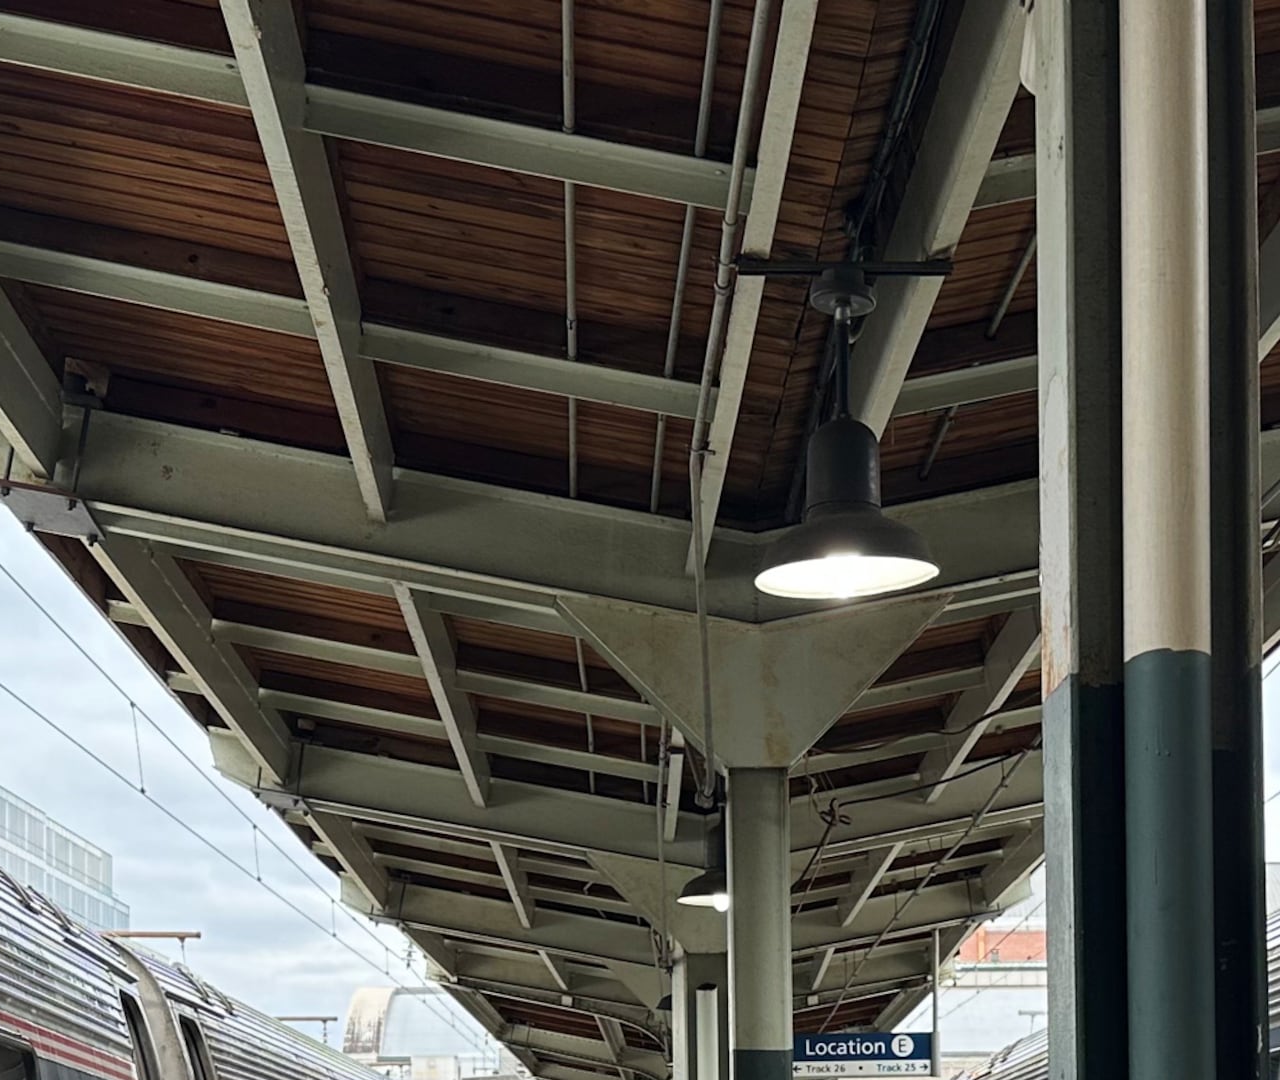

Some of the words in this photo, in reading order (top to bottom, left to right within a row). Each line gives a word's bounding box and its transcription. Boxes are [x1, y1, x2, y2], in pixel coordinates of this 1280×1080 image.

[805, 1038, 886, 1056] Location
[806, 1064, 831, 1074] Track
[834, 1063, 846, 1073] 26
[877, 1063, 901, 1073] Track
